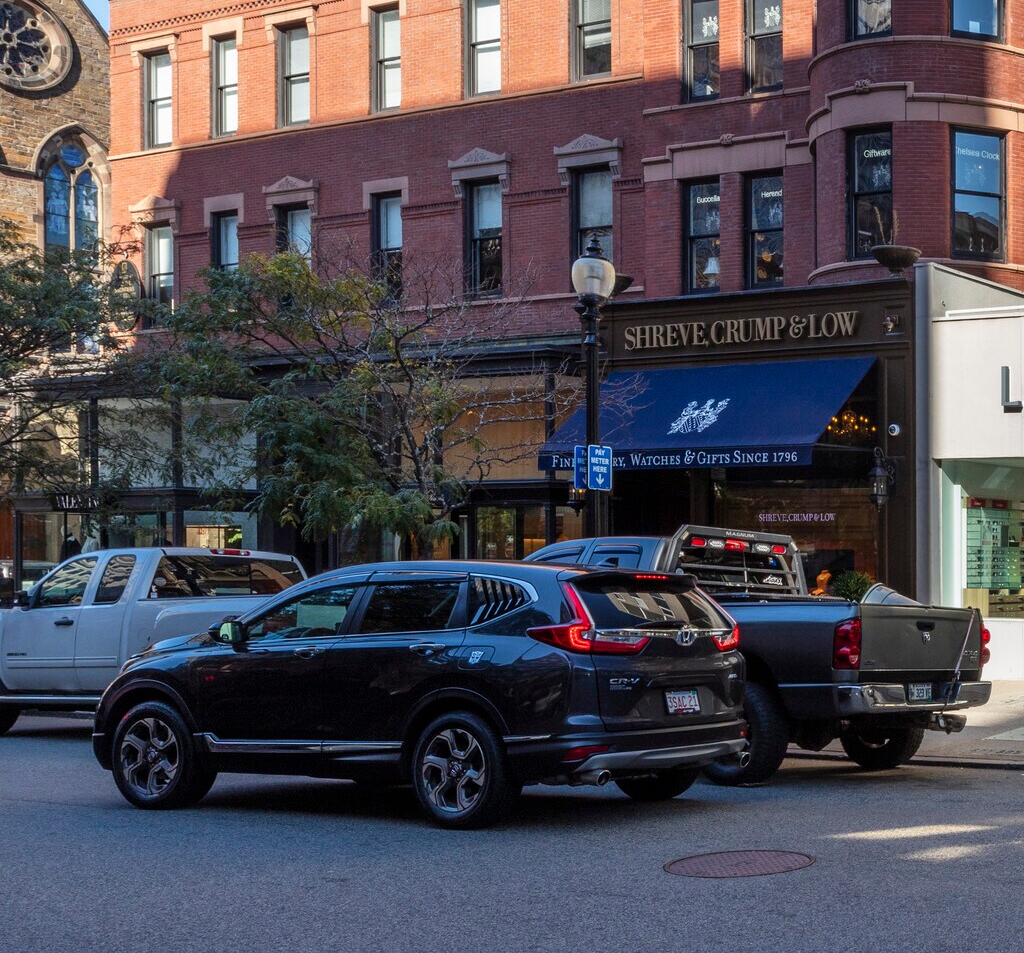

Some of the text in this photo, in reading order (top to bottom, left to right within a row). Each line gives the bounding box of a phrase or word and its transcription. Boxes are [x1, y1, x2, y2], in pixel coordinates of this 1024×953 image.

[624, 310, 860, 351] SHREVE, CRUMP & LOW
[594, 448, 606, 456] PAY
[590, 456, 609, 465] METER
[683, 449, 695, 465] &
[773, 451, 798, 463] 1796
[592, 465, 607, 473] HERE
